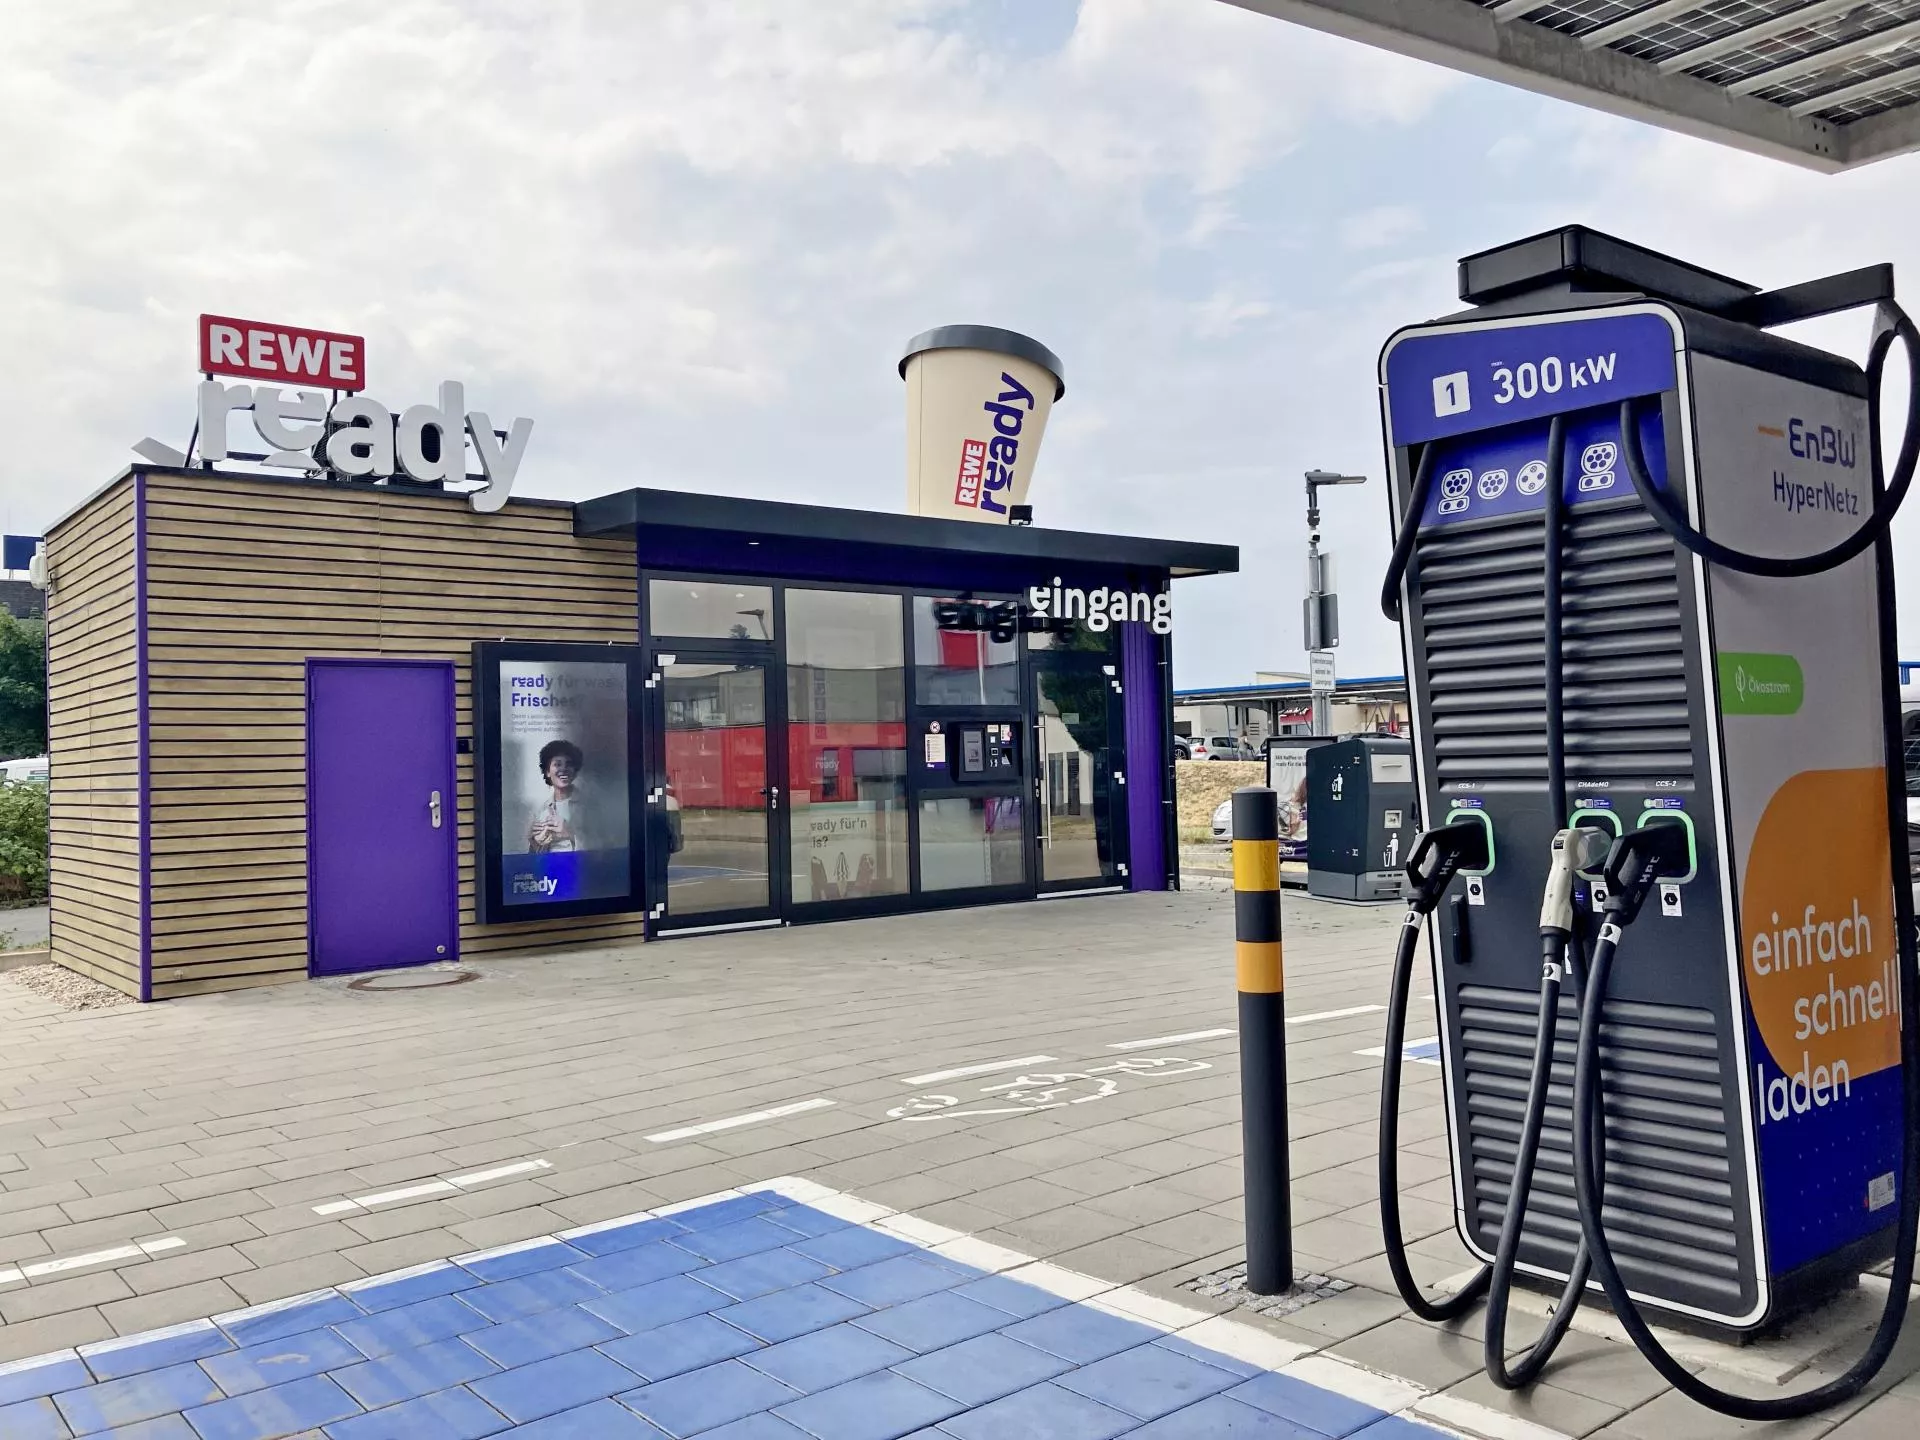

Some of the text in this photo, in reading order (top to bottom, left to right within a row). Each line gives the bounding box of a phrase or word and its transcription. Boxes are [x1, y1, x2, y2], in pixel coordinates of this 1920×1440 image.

[208, 323, 357, 381] REWE
[1445, 352, 1617, 407] 1 300 kW
[198, 379, 535, 514] ready
[979, 371, 1035, 516] ready
[1788, 417, 1856, 469] EnBW
[957, 442, 984, 505] REWE
[1773, 470, 1859, 516] HyperNetz
[1028, 576, 1172, 635] eingang
[511, 673, 553, 692] ready
[1748, 674, 1791, 694] Ökostrom
[1752, 897, 1872, 976] einfach
[1793, 957, 1899, 1041] schnell
[1757, 1050, 1851, 1126] laden
